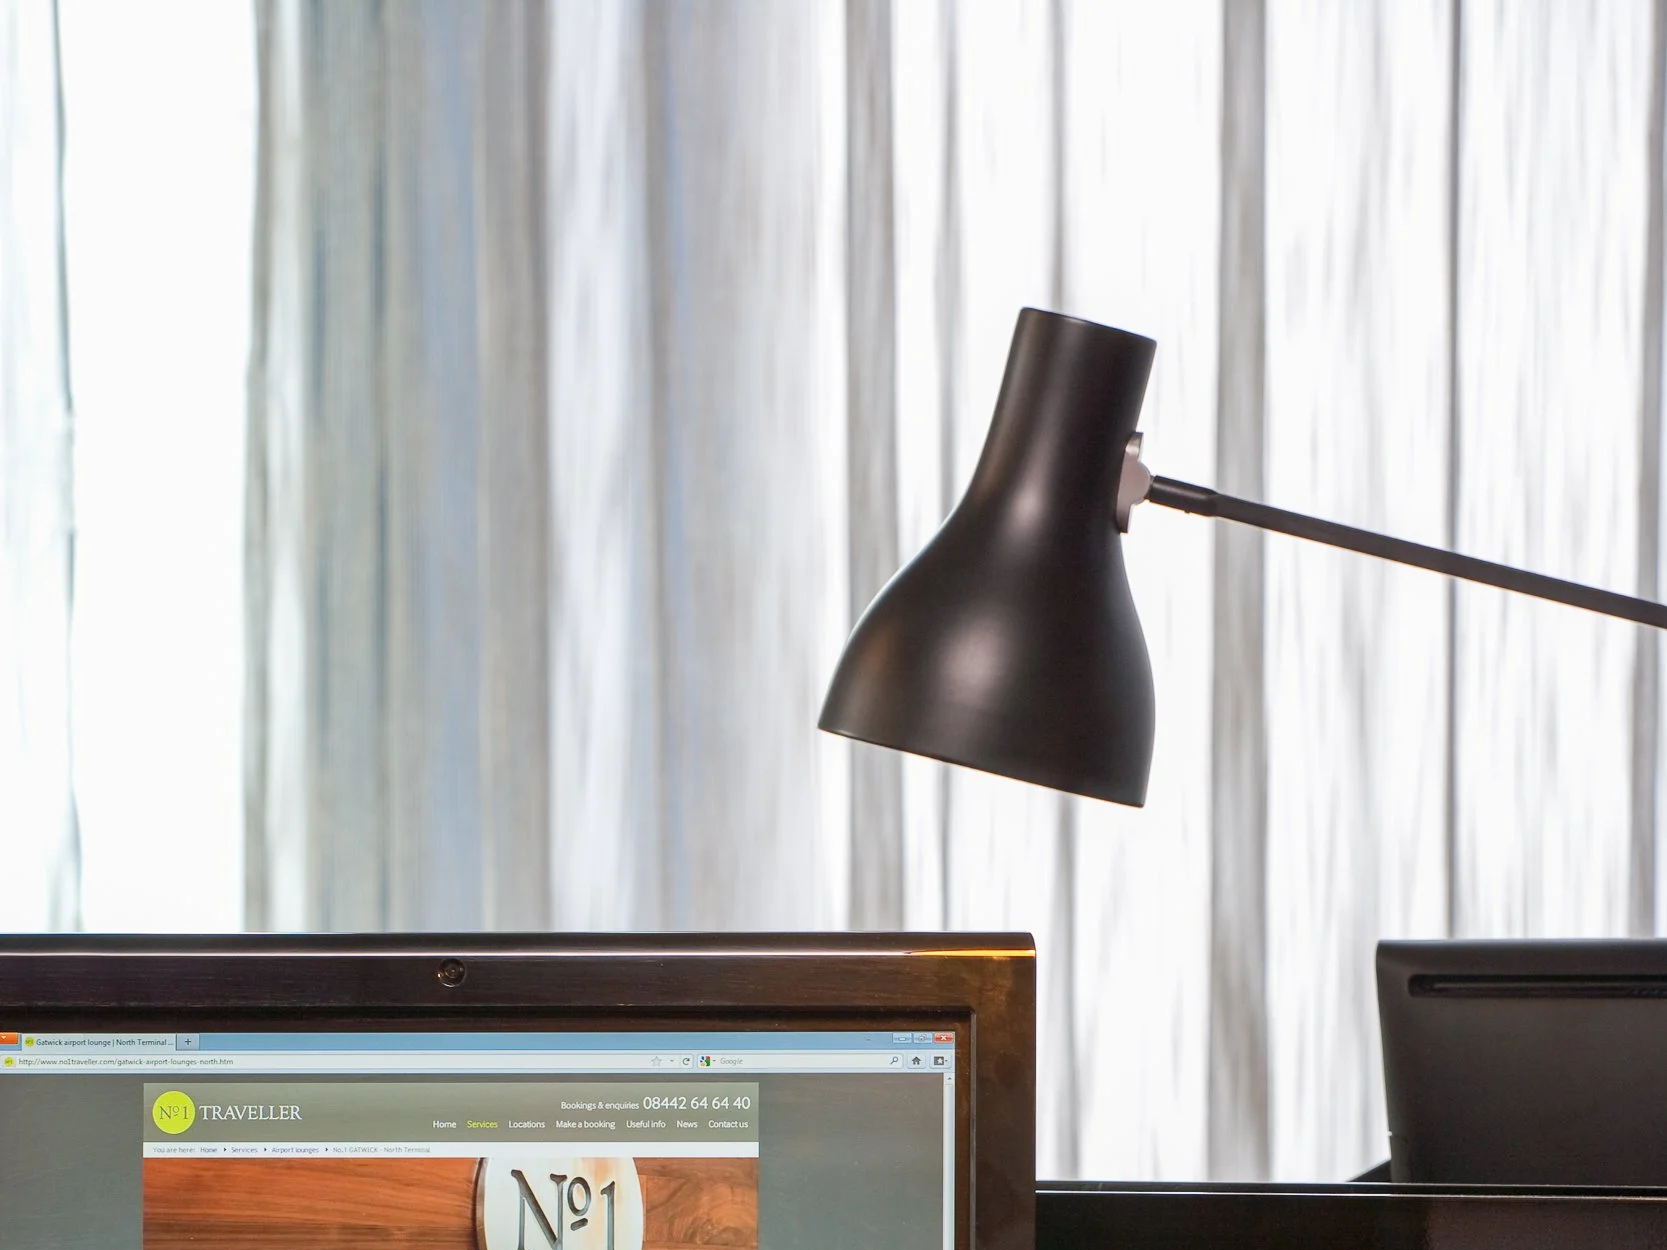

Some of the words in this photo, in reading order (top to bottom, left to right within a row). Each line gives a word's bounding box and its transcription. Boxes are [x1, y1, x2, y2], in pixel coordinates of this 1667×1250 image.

[88, 1039, 111, 1047] lounge
[720, 1058, 743, 1066] Google
[561, 1102, 596, 1111] Bookings
[597, 1102, 604, 1110] &
[605, 1102, 639, 1110] enquiries
[643, 1097, 686, 1110] 08442
[691, 1097, 708, 1109] 64
[712, 1097, 729, 1109] 64
[733, 1097, 750, 1109] 40
[199, 1106, 302, 1120] TRAVELLER
[433, 1120, 456, 1128] Home
[466, 1120, 498, 1128] Services
[509, 1120, 545, 1128] Locations
[556, 1120, 576, 1128] Make
[583, 1120, 615, 1130] booking
[626, 1120, 650, 1128] Useful
[651, 1120, 666, 1128] info
[677, 1120, 698, 1128] News
[709, 1120, 738, 1128] Contact
